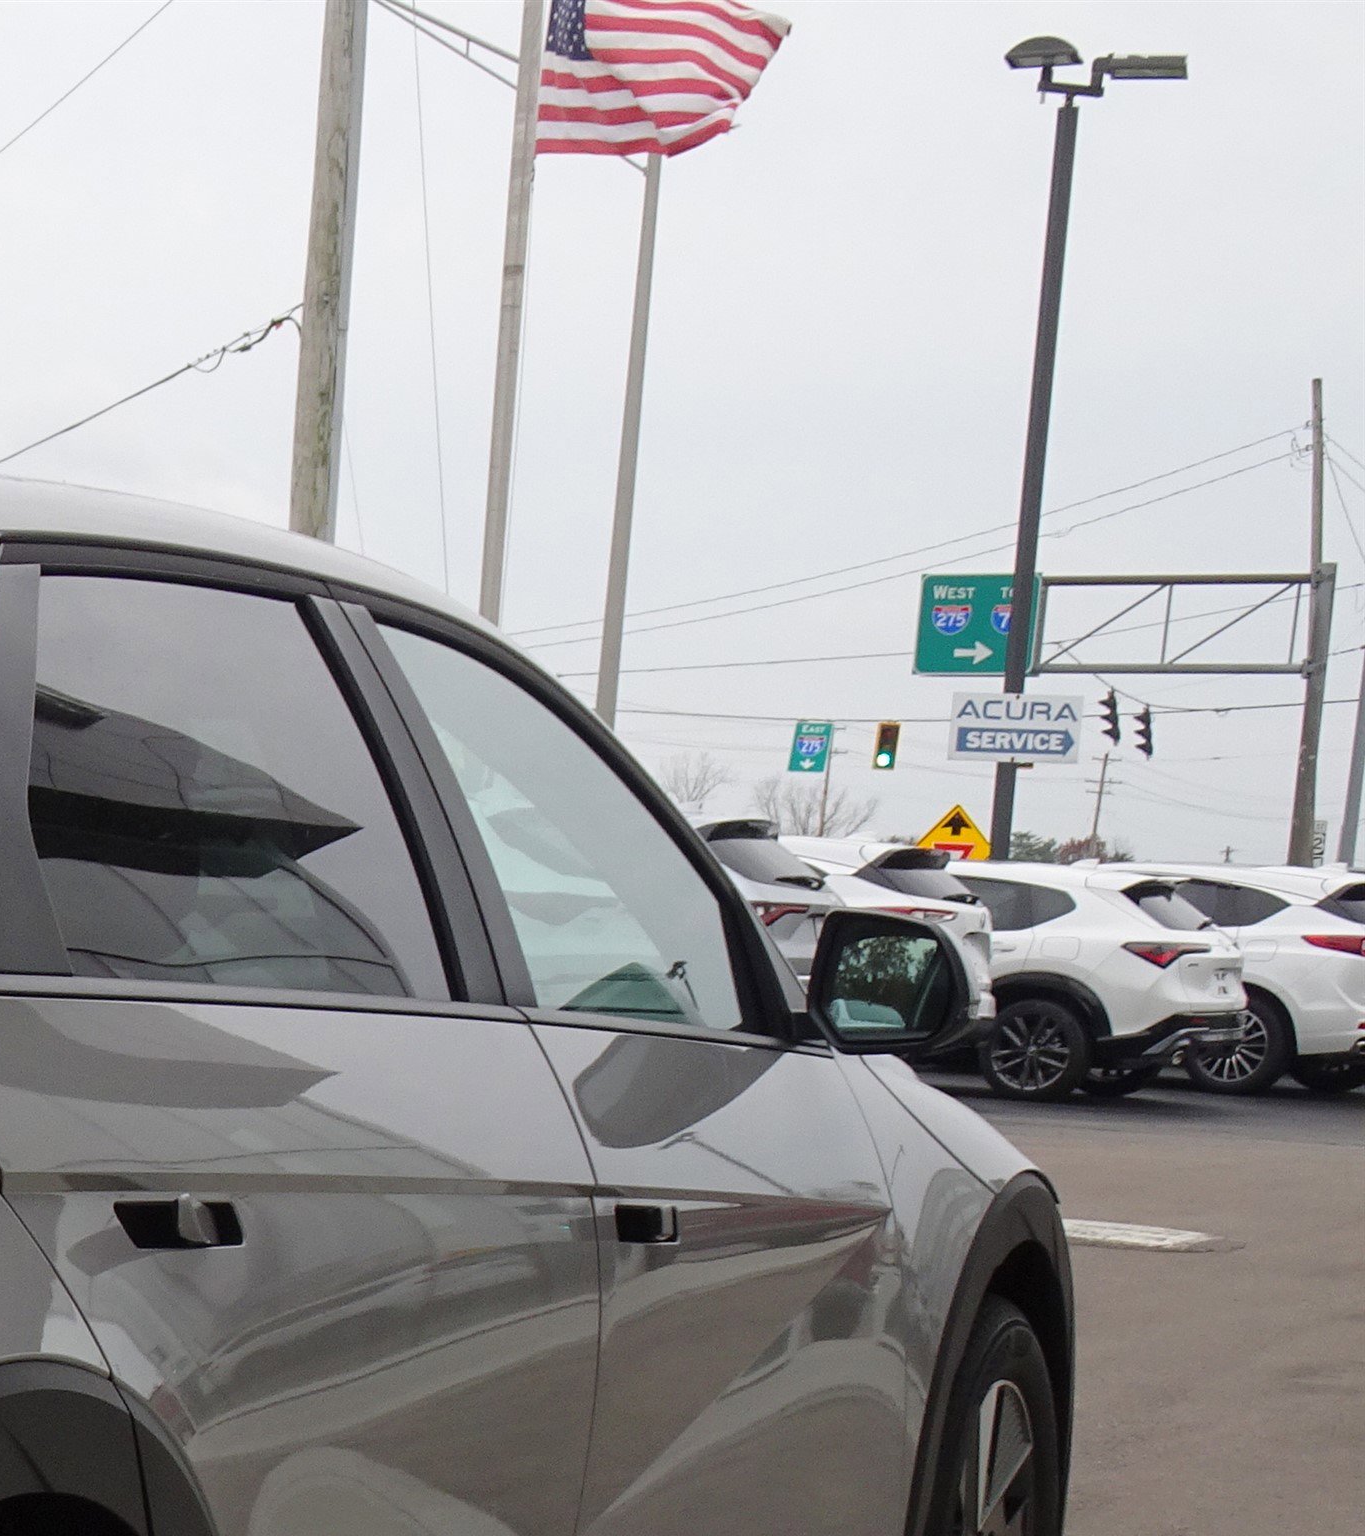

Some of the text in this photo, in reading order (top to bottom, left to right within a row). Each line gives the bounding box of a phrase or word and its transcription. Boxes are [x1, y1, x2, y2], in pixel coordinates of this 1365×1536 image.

[932, 585, 976, 600] WEST
[936, 613, 967, 628] 275
[999, 612, 1013, 629] 7
[957, 700, 1078, 722] ACURA
[801, 724, 826, 734] EAST
[801, 741, 821, 752] 275
[966, 731, 1064, 752] SERVICE
